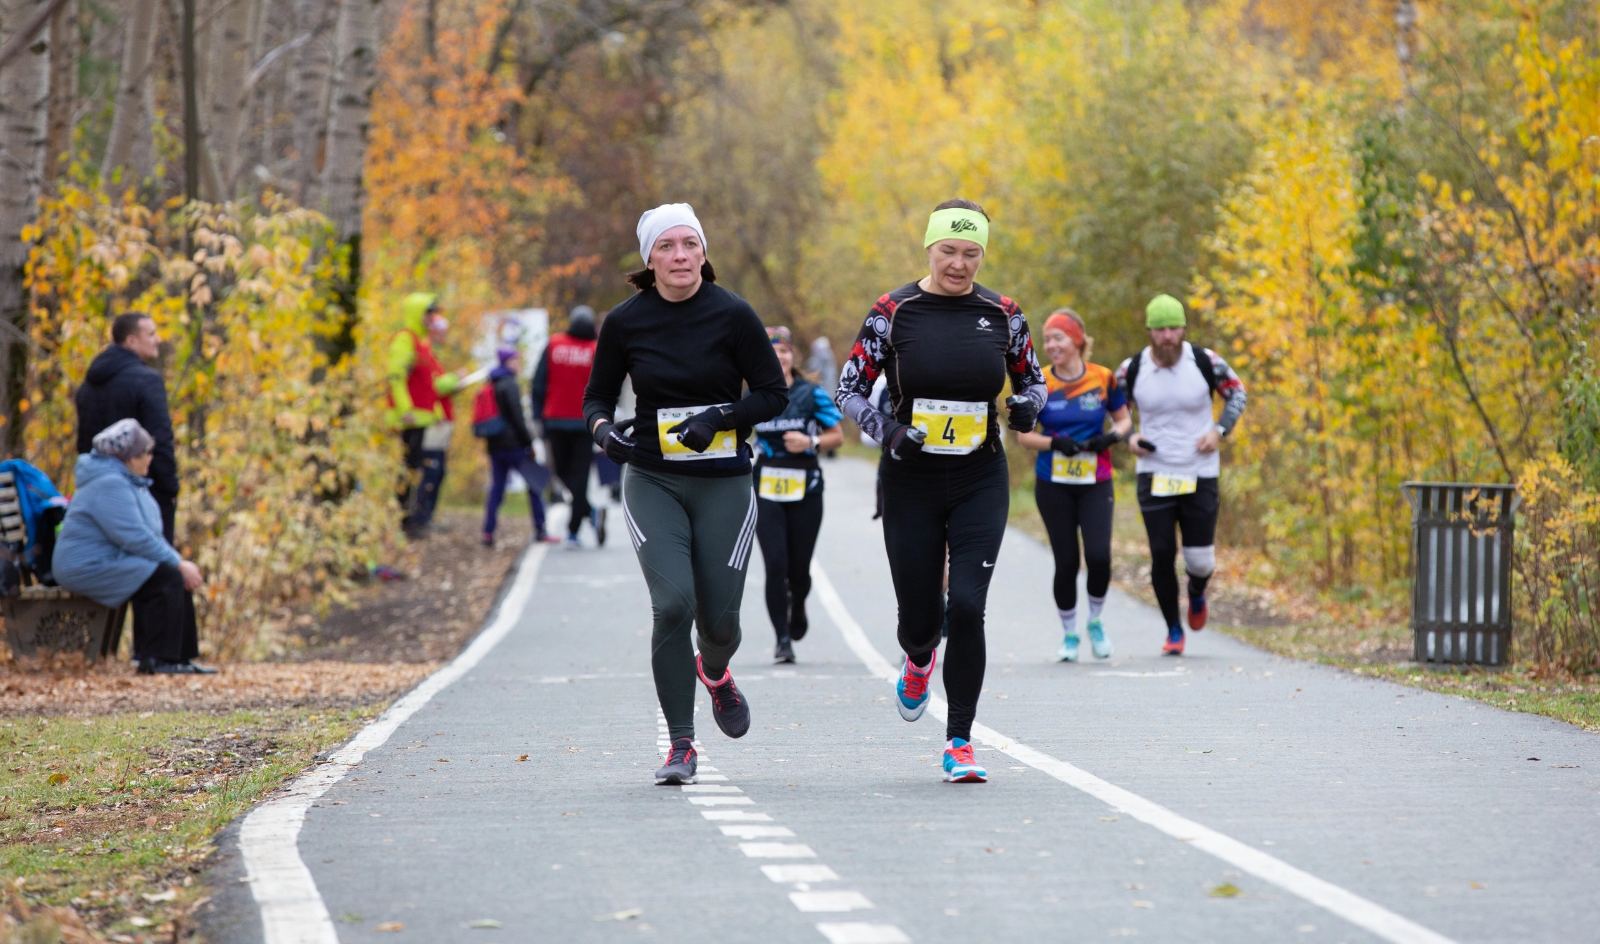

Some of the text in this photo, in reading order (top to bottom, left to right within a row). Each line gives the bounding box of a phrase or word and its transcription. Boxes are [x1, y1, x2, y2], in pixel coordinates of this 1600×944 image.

[942, 417, 955, 444] 4
[1067, 461, 1083, 477] 46
[776, 479, 789, 494] 61
